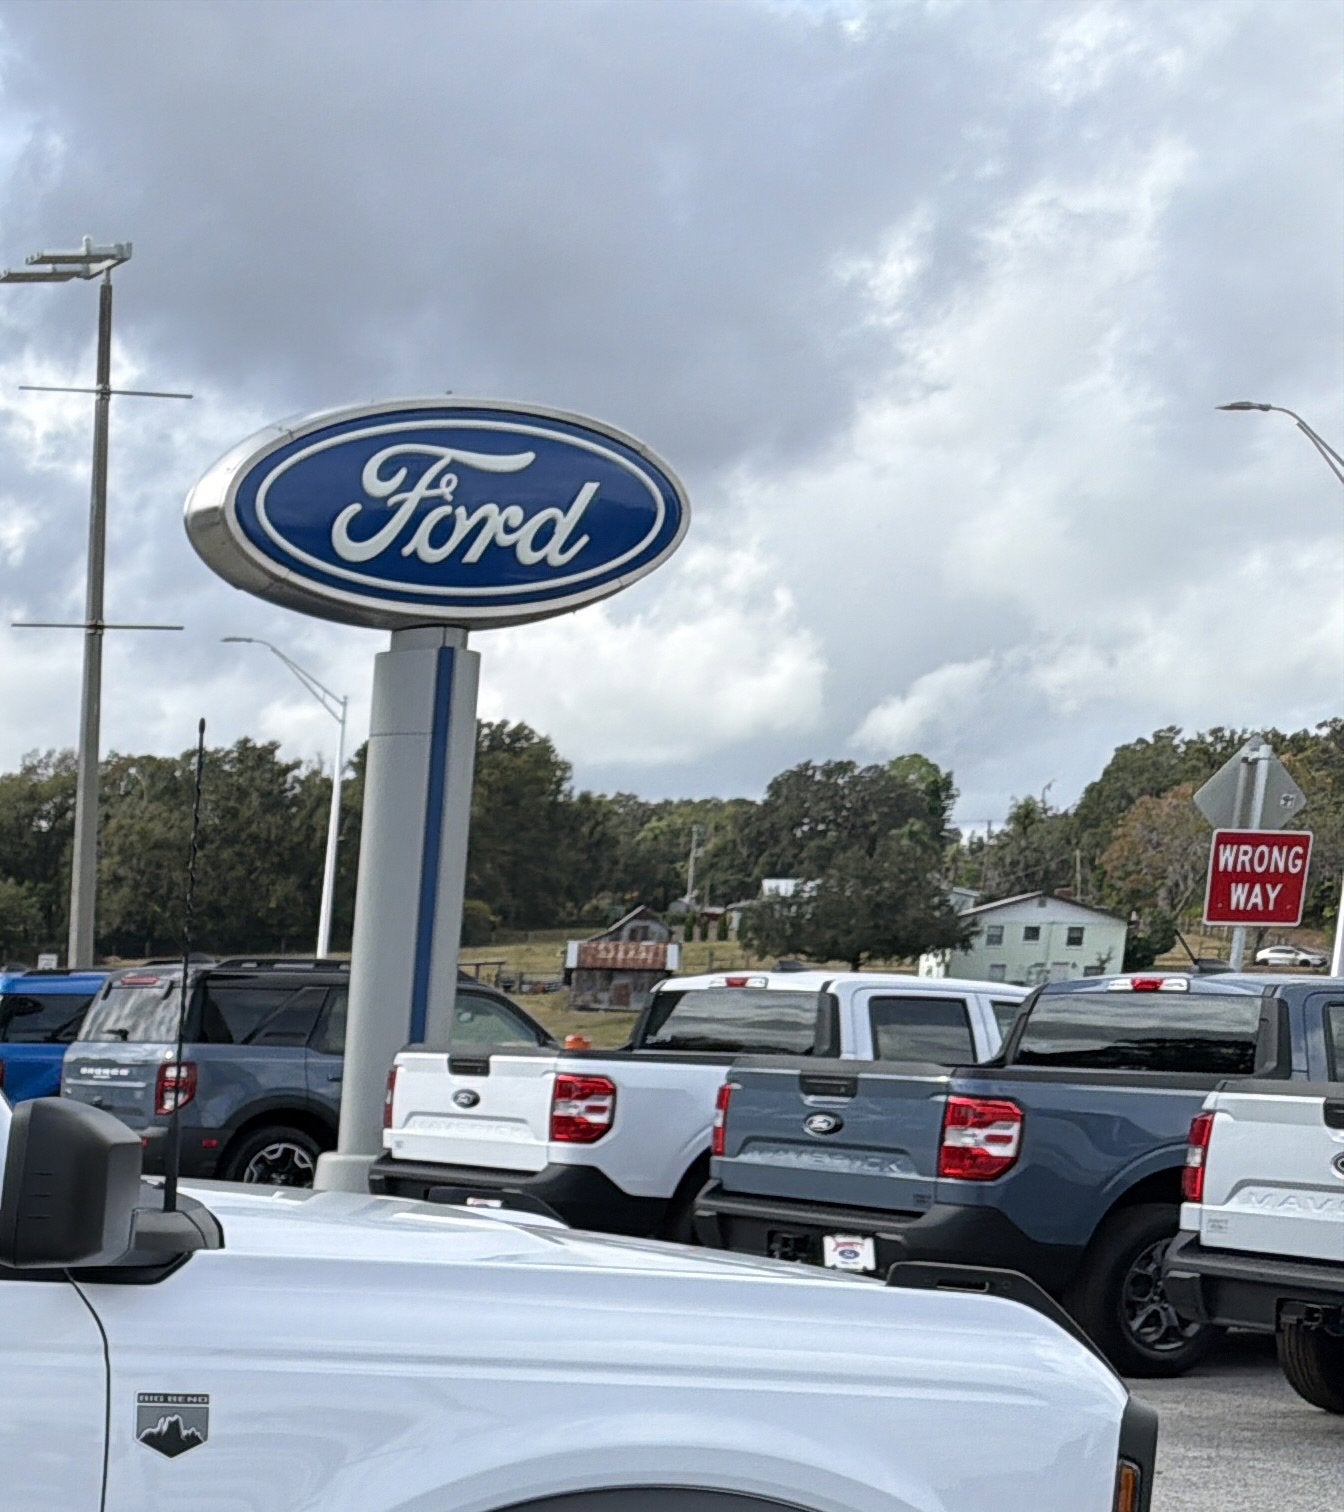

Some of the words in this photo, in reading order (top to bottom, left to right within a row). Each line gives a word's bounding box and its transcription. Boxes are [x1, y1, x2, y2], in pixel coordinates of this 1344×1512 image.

[330, 443, 602, 567] Ford
[1218, 843, 1304, 875] WRONG
[1229, 882, 1284, 911] WAY
[1243, 1190, 1344, 1215] MAV
[167, 1395, 208, 1403] BEND
